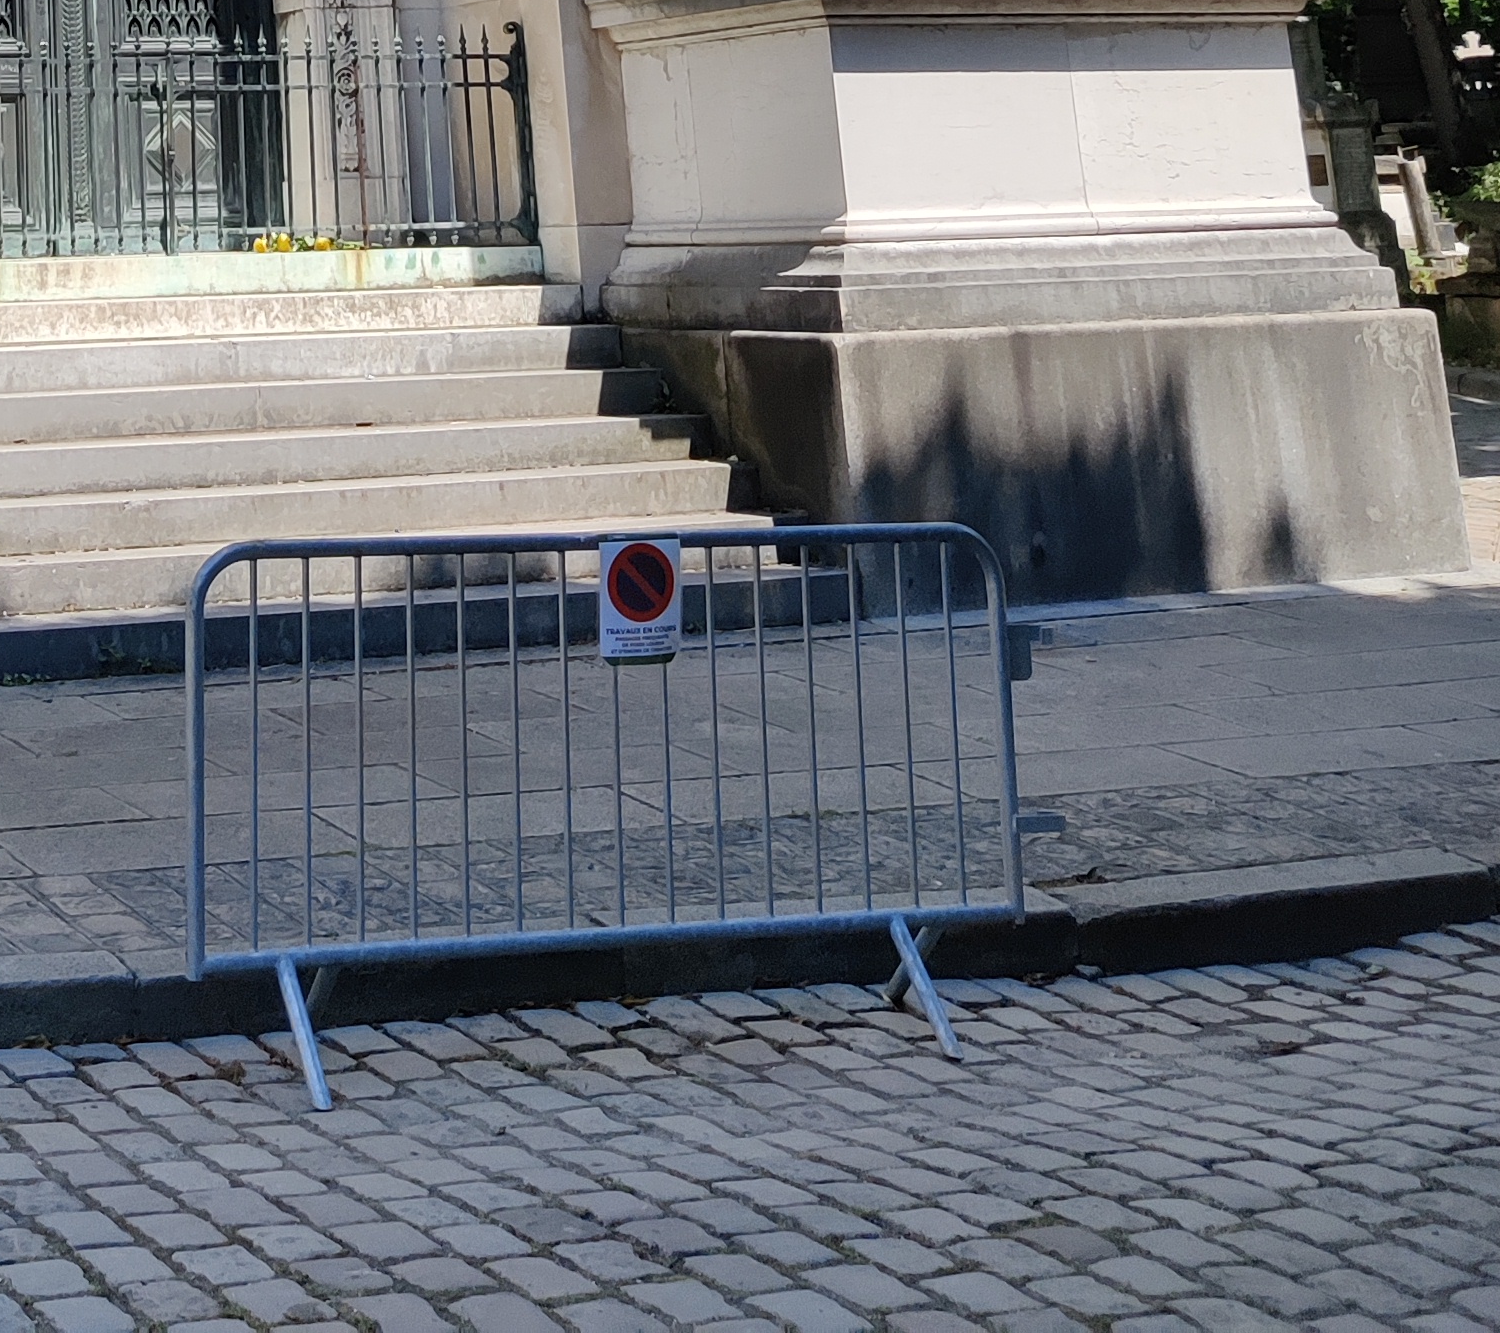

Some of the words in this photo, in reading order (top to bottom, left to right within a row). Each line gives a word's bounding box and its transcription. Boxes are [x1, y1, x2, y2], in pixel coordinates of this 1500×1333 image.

[605, 627, 641, 635] TRAVAUX
[642, 626, 653, 634] EN
[654, 624, 677, 633] COURS
